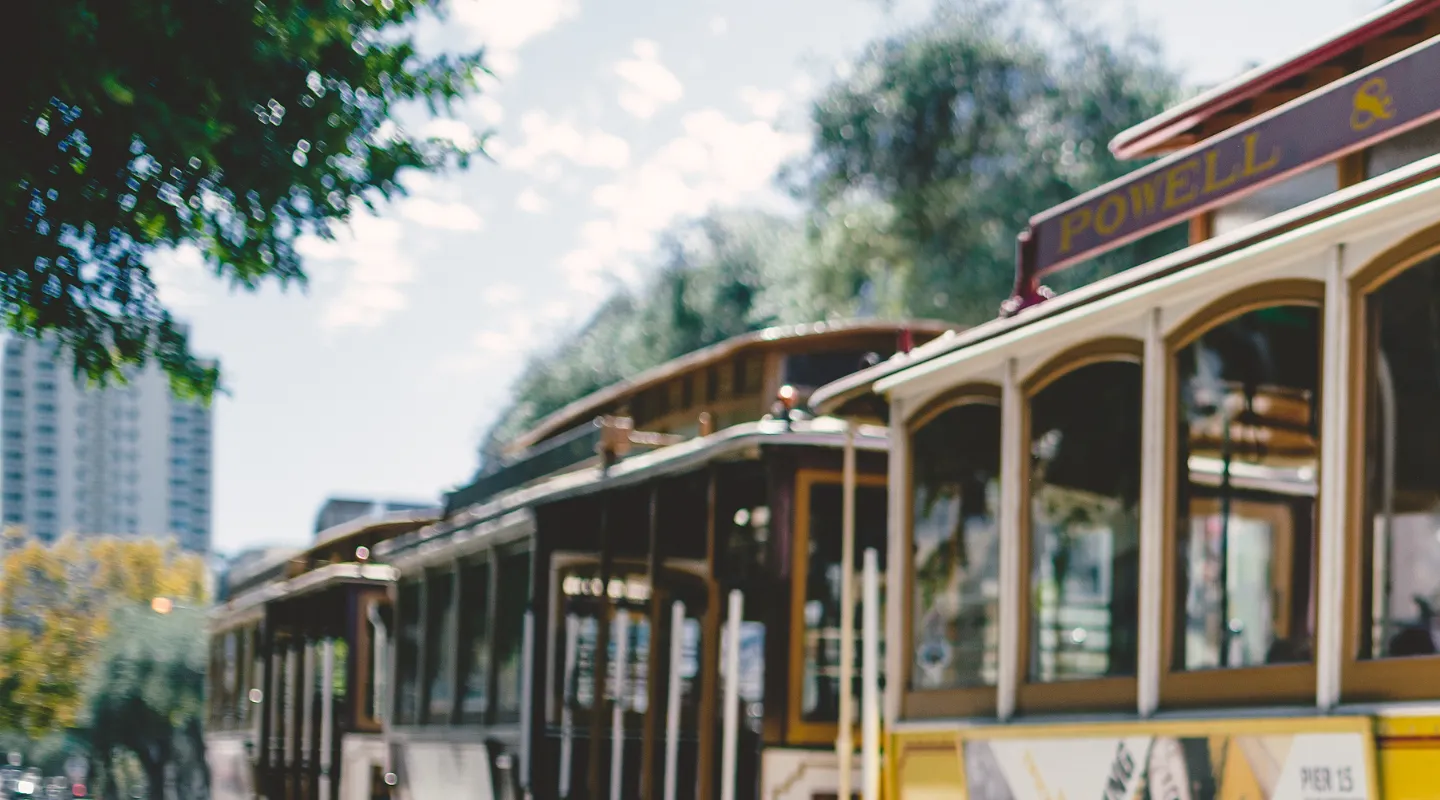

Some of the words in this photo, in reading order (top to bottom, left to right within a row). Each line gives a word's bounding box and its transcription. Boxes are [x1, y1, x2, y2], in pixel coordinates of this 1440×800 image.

[1060, 132, 1281, 252] POWELL
[1349, 77, 1397, 132] &
[1300, 765, 1332, 791] PIER
[1336, 764, 1353, 792] 15
